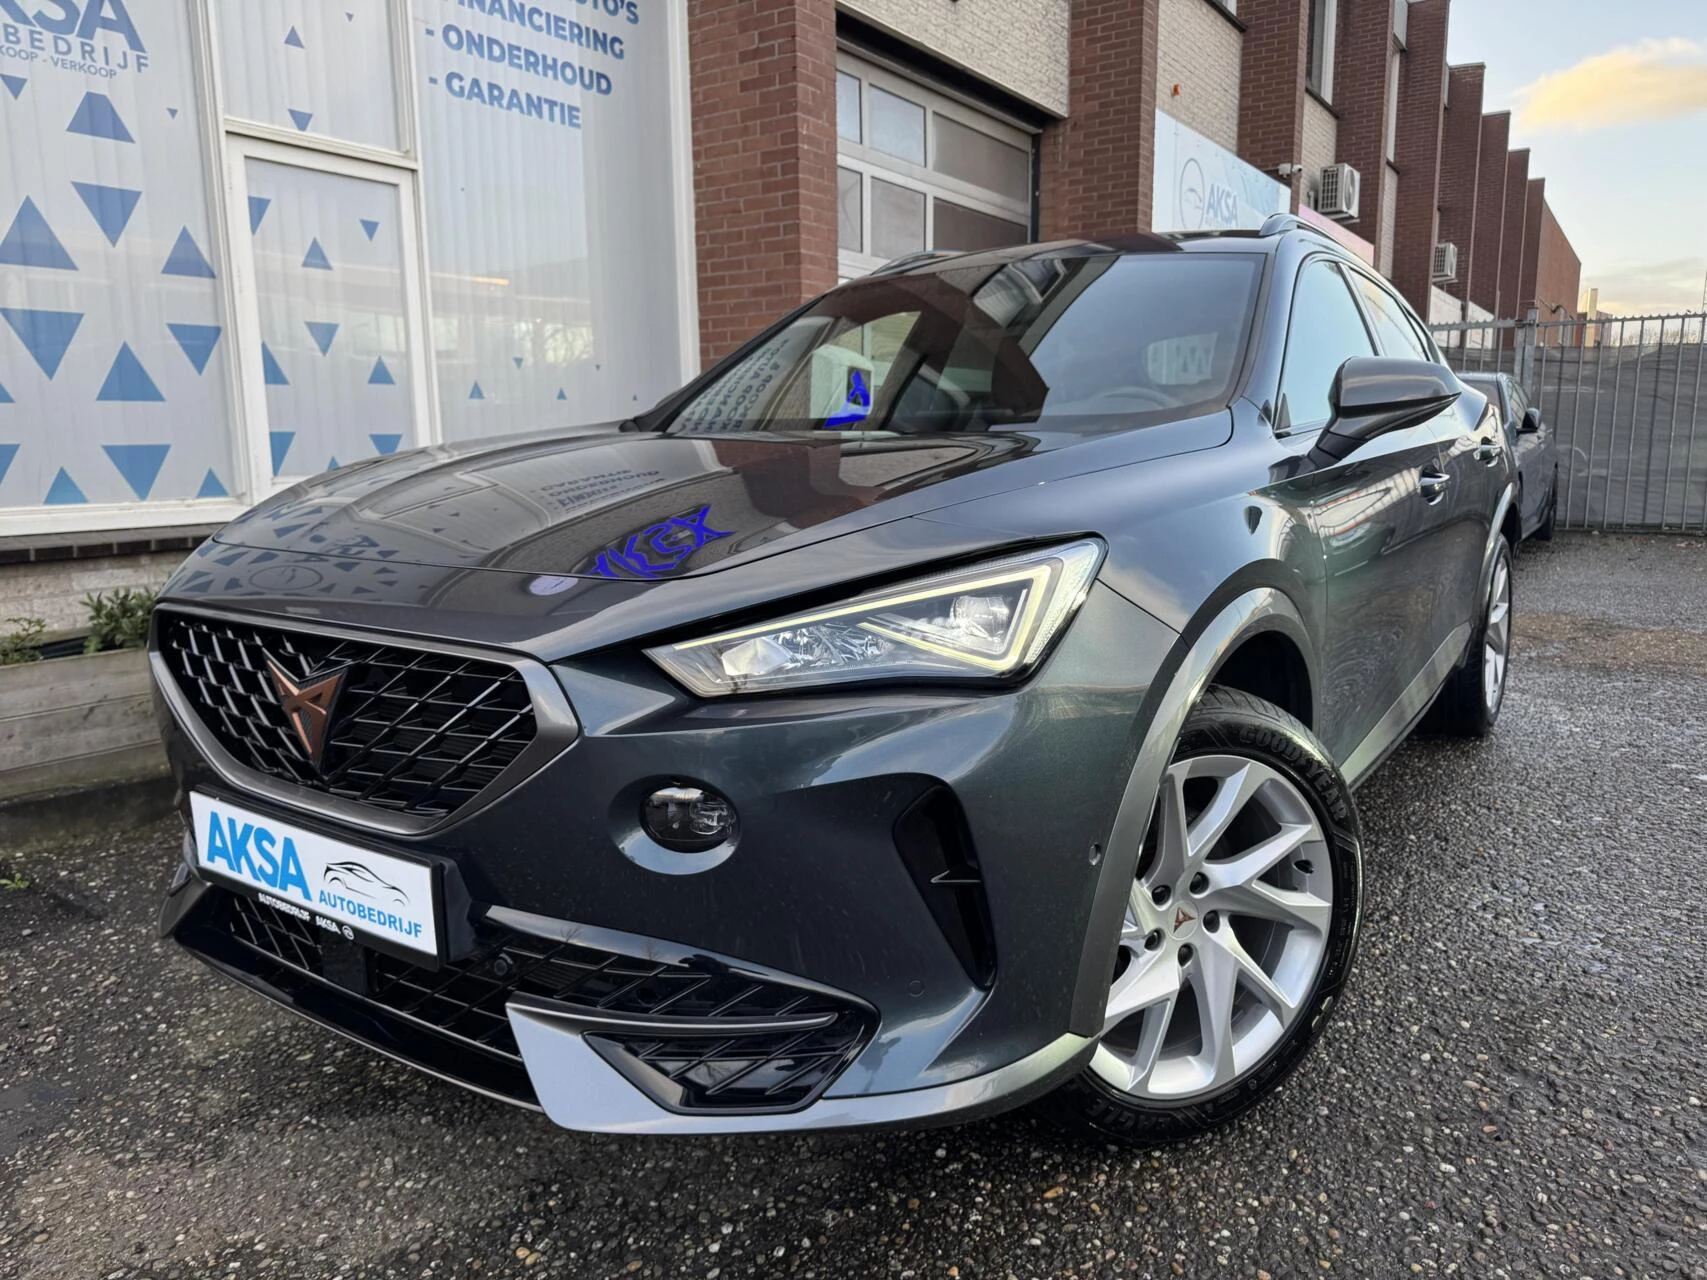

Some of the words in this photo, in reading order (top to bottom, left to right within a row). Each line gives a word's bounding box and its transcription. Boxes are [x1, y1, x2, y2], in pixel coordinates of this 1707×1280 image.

[0, 0, 147, 53] SA
[2, 22, 150, 73] BEDRIJF
[50, 55, 118, 79] VERKOOP
[441, 23, 613, 96] ONDERHOUD
[445, 71, 582, 129] GARANTIE
[1206, 183, 1239, 227] AKSA
[207, 811, 312, 901] AKSA
[319, 889, 422, 938] AUTOBEDRIJF
